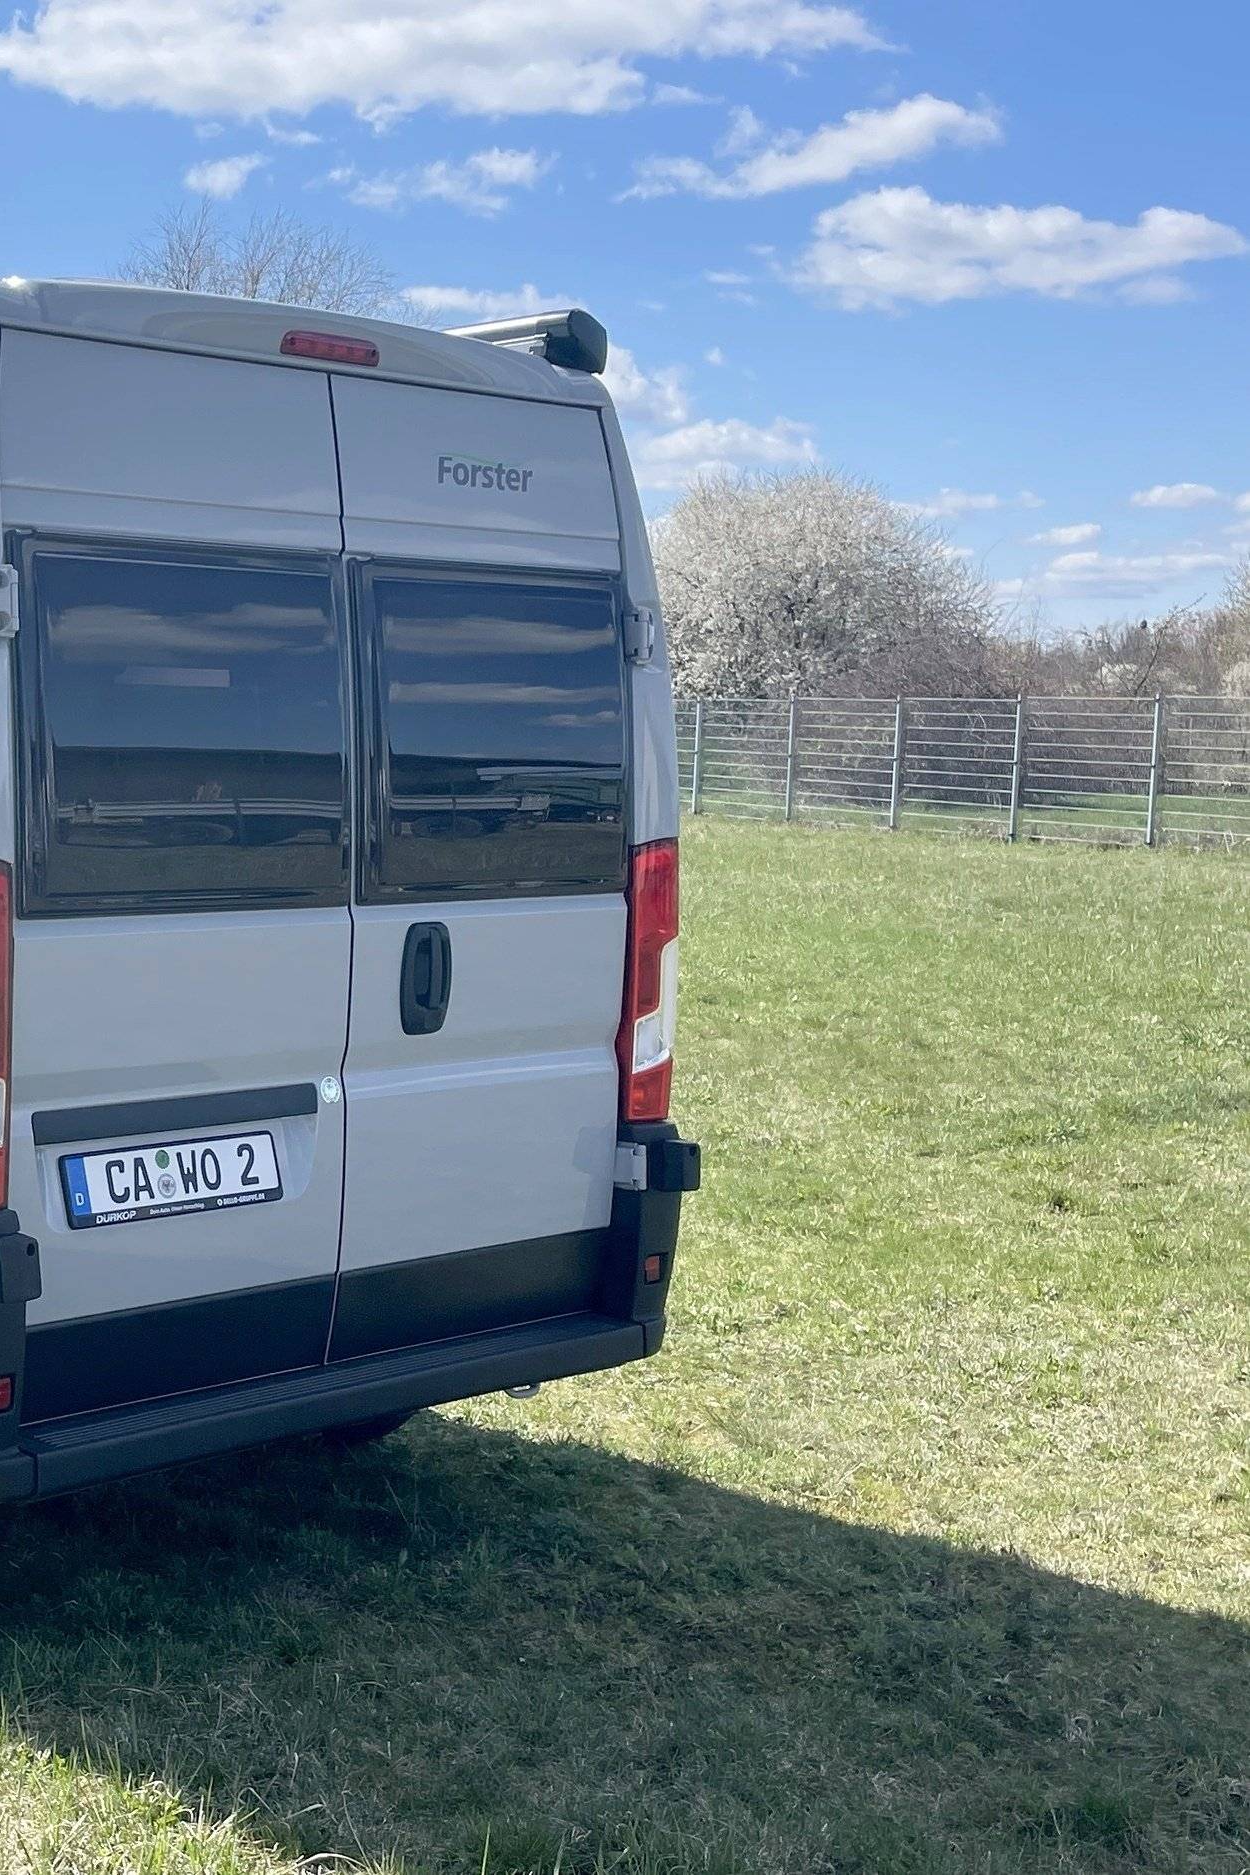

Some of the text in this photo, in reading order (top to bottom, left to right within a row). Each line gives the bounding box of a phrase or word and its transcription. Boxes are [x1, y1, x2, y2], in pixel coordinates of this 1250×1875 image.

[437, 456, 533, 492] Forster
[105, 1143, 260, 1203] CA WO 2
[75, 1192, 85, 1206] D
